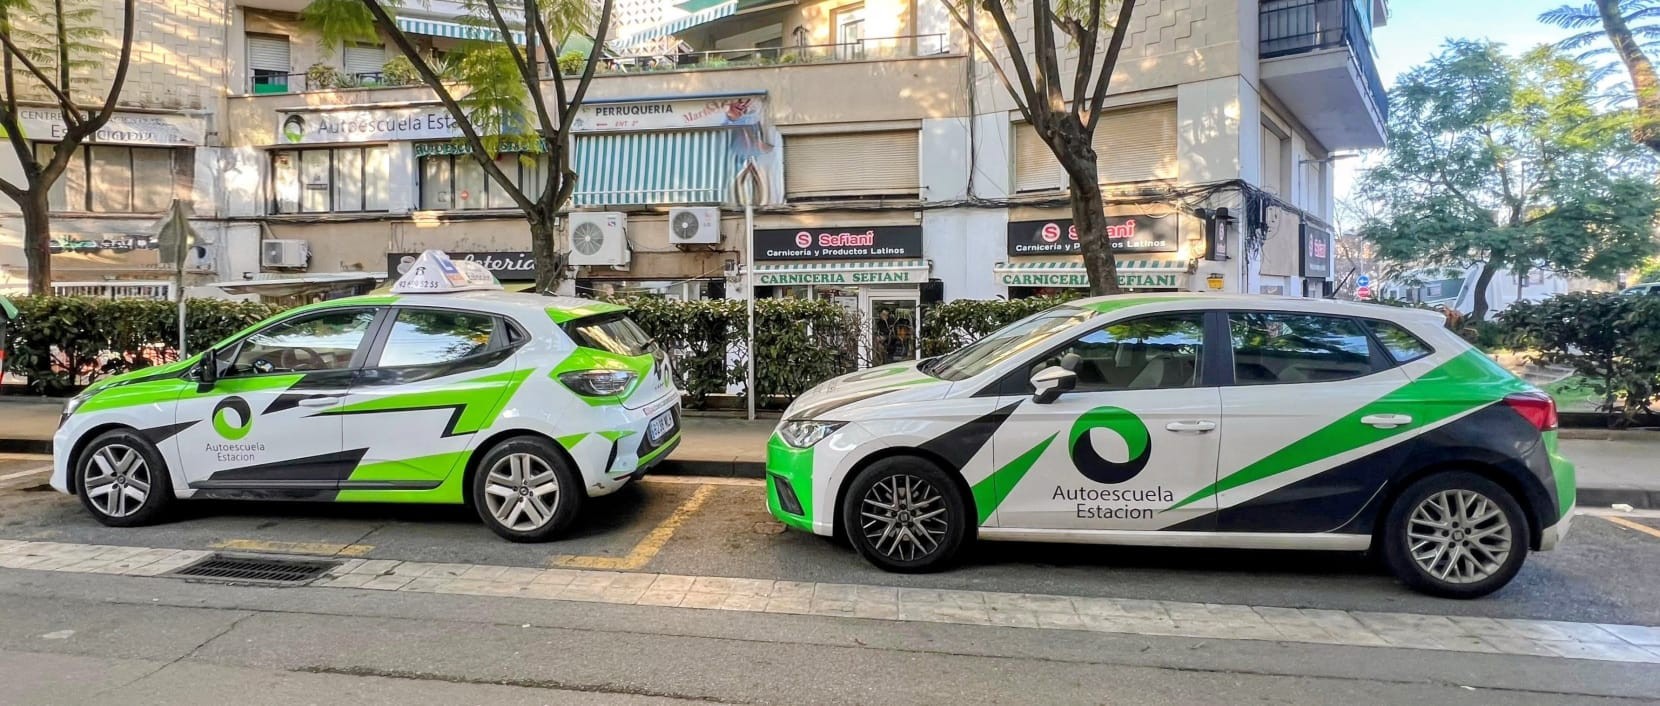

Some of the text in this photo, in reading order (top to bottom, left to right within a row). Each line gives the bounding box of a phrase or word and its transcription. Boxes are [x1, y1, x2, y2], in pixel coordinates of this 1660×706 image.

[595, 104, 673, 117] PERRUQUERIA
[318, 114, 421, 135] Autoescuela
[1068, 220, 1136, 240] Sani
[1065, 243, 1071, 251] y
[1126, 240, 1167, 248] Latinos
[822, 247, 868, 255] Productos
[870, 247, 904, 255] Latinos
[760, 272, 909, 284] CARNICERIA SEFIANI
[1116, 274, 1176, 286] EFIANI
[206, 442, 265, 452] Autoescuela
[217, 452, 255, 462] Estacion
[1052, 485, 1174, 502] Autoescuela
[1076, 503, 1153, 519] Estacion
